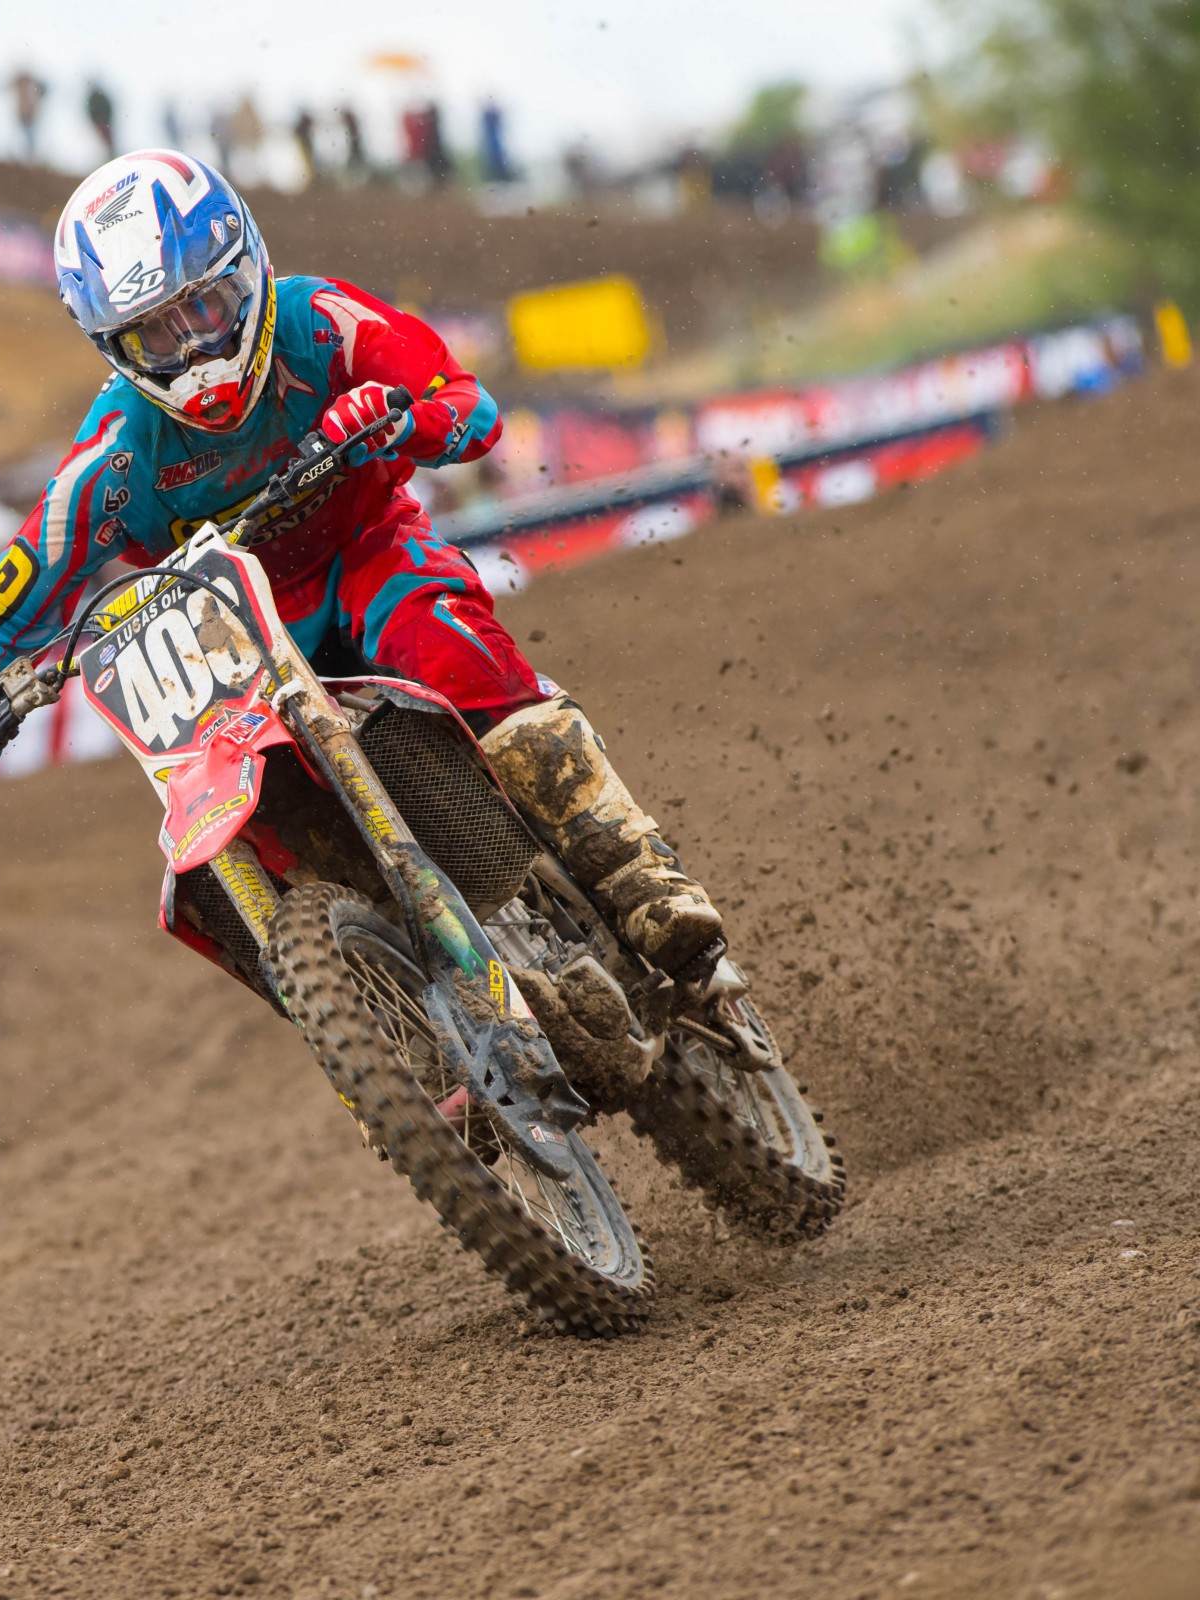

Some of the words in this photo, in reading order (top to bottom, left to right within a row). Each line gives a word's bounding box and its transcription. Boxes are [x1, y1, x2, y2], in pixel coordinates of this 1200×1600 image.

[85, 171, 140, 219] AMSOIL
[97, 209, 144, 235] HONDA
[109, 261, 166, 305] 6D
[200, 393, 216, 406] 6D
[157, 450, 222, 491] AMSOIL
[297, 455, 335, 487] ARC
[103, 486, 130, 514] 6D
[251, 474, 350, 546] ONDA
[116, 604, 158, 649] LUCAS
[161, 585, 186, 610] OIL
[239, 755, 253, 791] DUNLOP
[174, 793, 249, 861] GEICO
[181, 810, 244, 863] HONDA
[489, 960, 504, 1014] EICO
